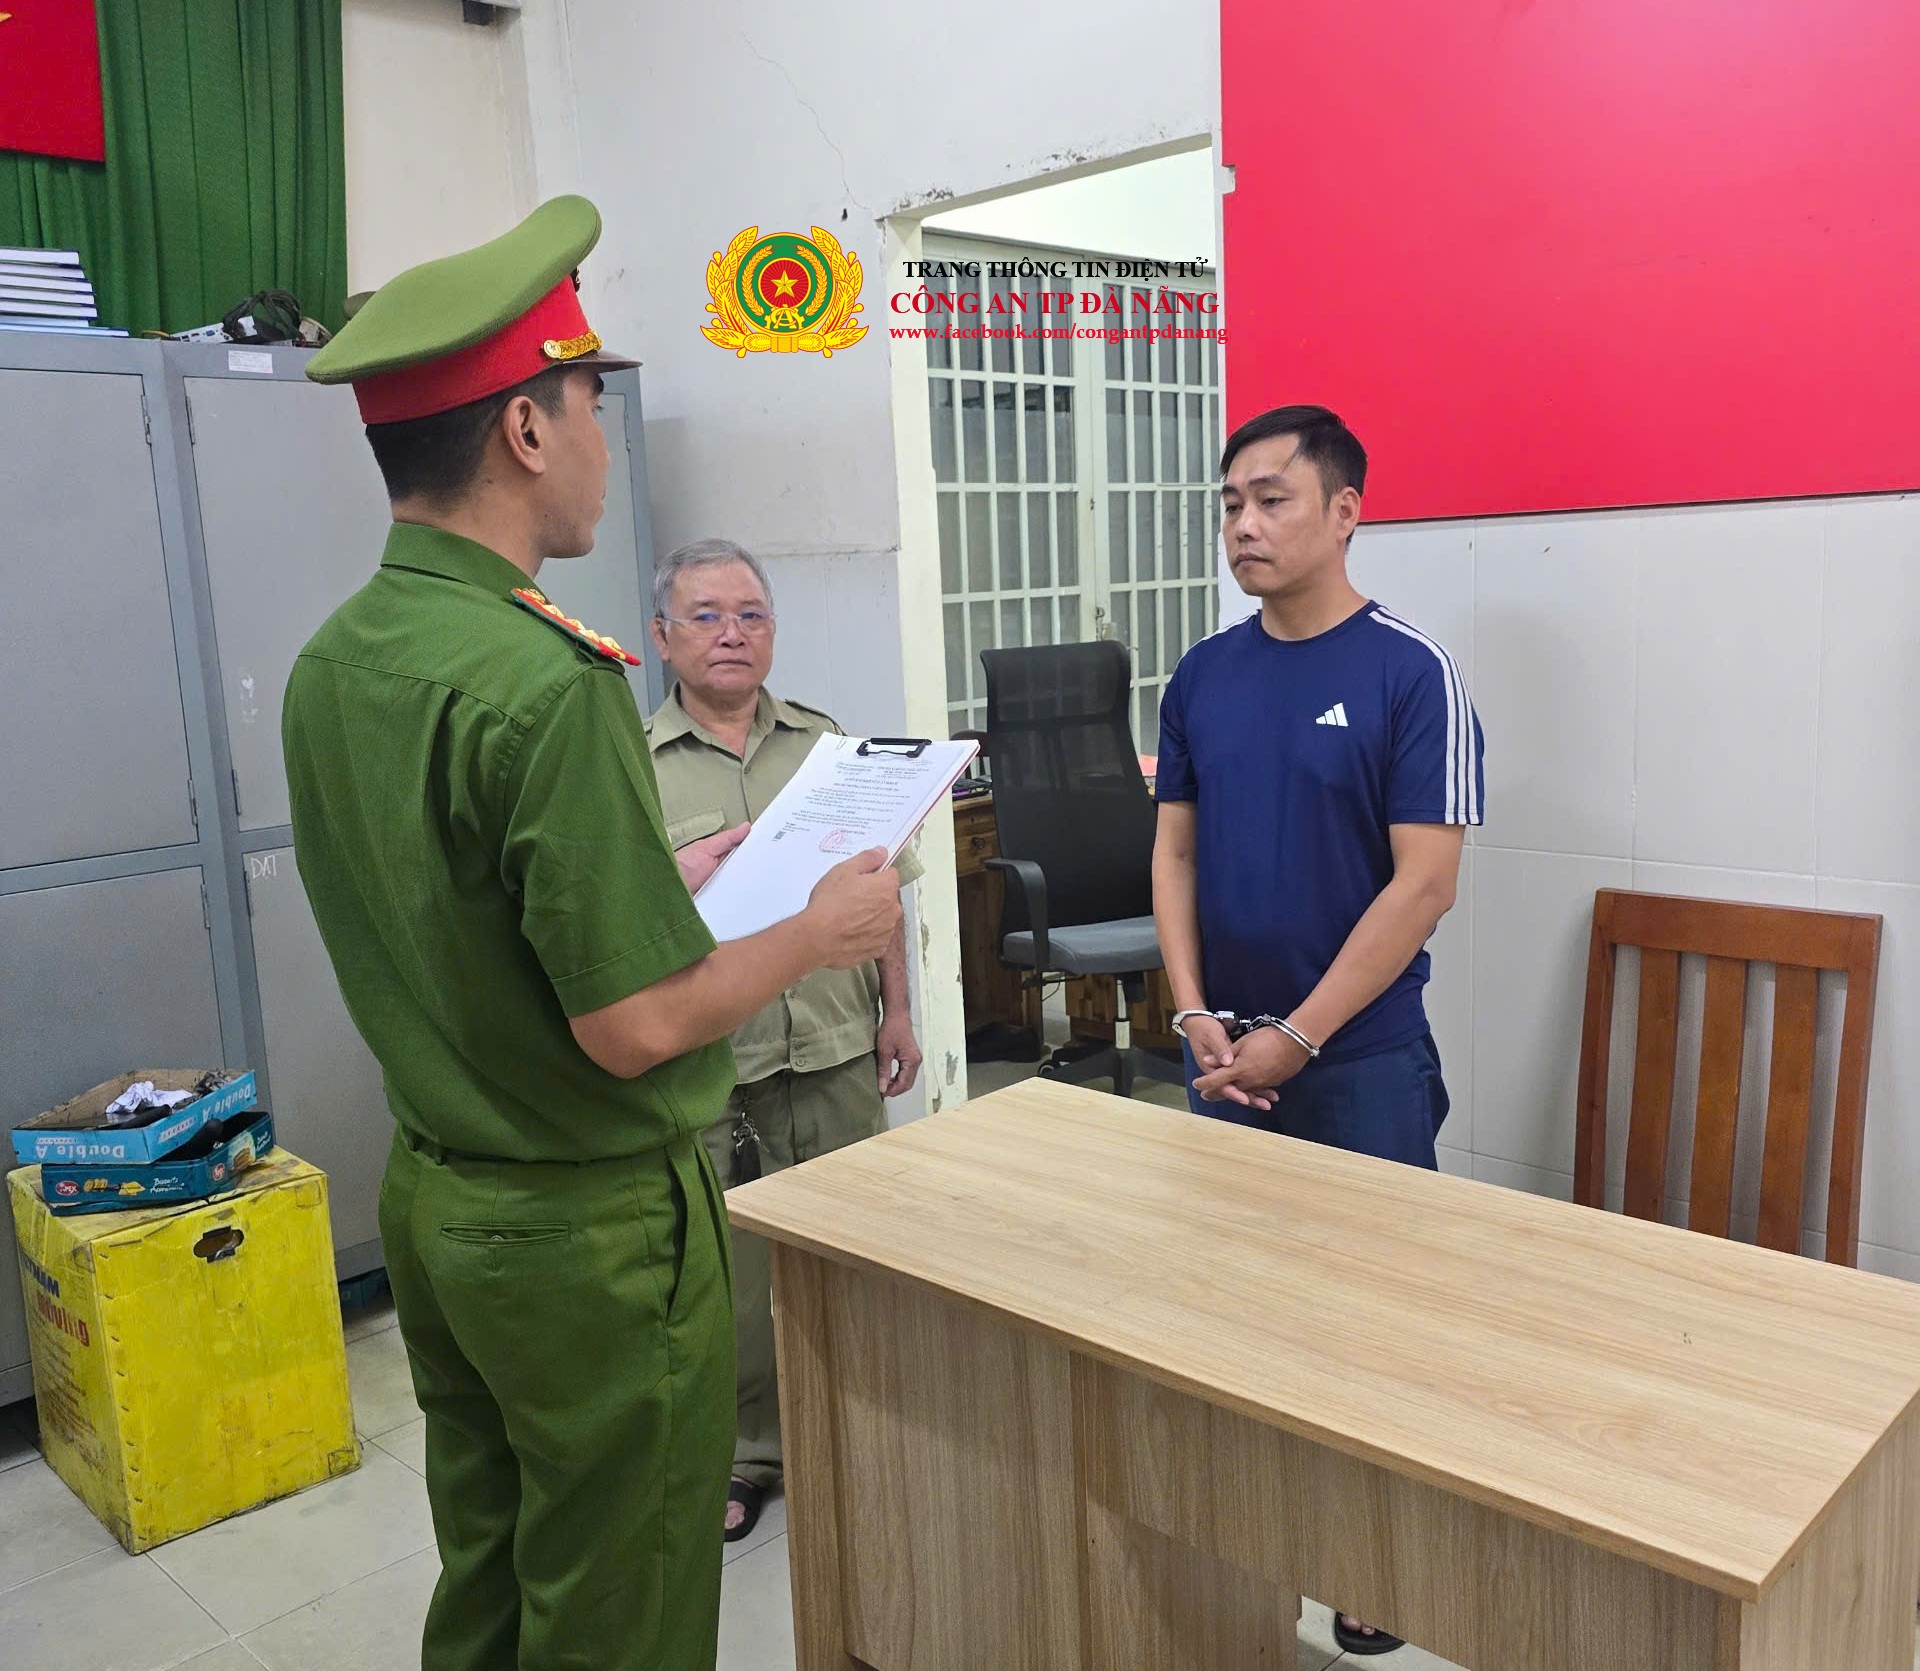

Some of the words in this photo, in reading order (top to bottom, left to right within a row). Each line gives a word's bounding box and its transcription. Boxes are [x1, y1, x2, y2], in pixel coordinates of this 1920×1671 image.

[214, 1084, 251, 1114] Double
[35, 1144, 49, 1159] A
[56, 1144, 125, 1159] Double
